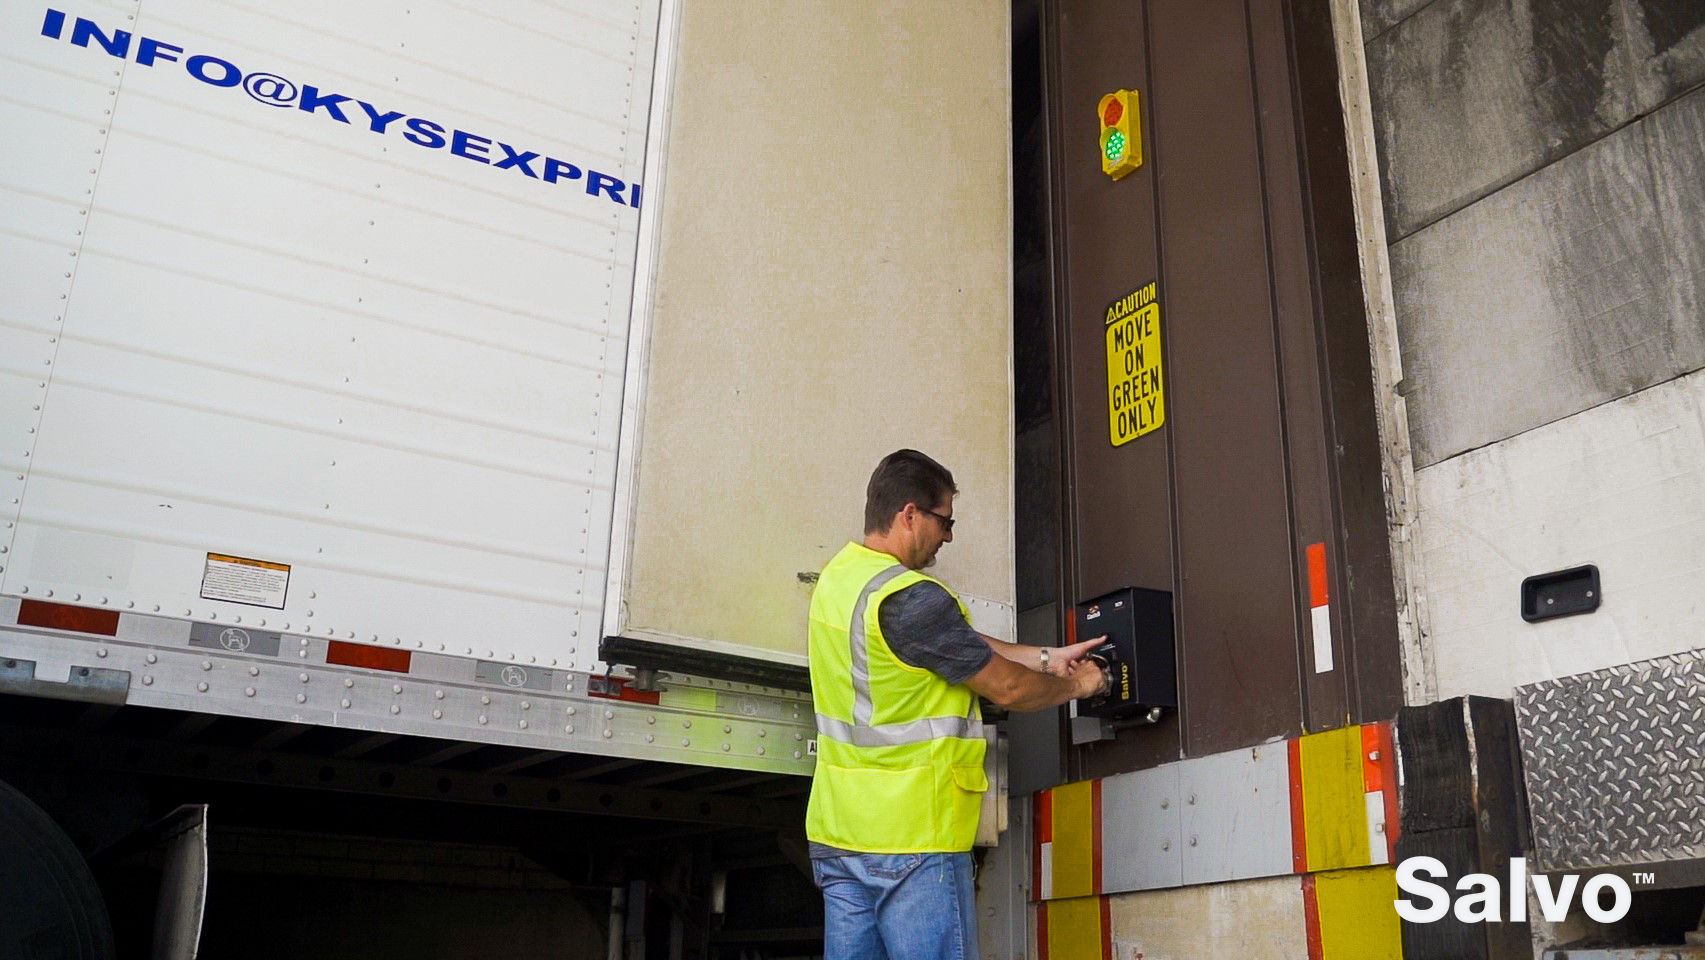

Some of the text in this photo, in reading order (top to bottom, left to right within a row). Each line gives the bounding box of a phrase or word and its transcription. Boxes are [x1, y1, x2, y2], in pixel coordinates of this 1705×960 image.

[1115, 281, 1156, 319] CAUTION
[1114, 310, 1153, 353] MOVE
[1124, 343, 1145, 376] ON
[1112, 365, 1160, 411] GREEN
[1117, 396, 1157, 439] ONLY
